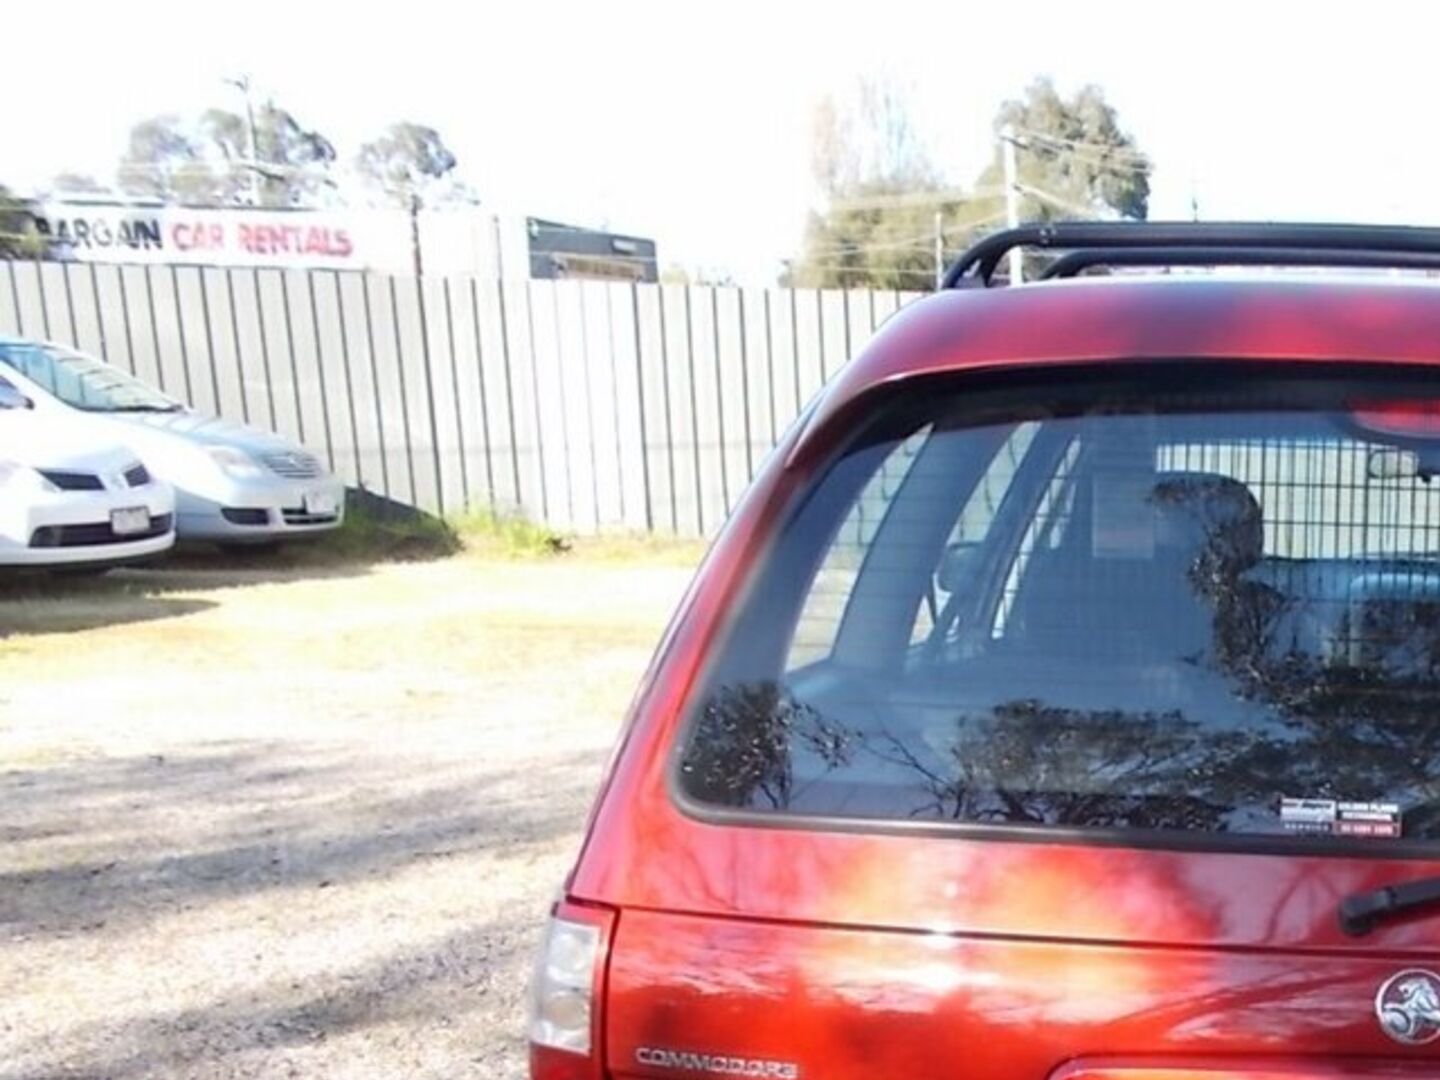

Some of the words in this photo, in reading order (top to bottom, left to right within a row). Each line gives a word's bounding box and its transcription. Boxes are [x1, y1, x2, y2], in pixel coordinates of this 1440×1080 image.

[172, 222, 224, 251] CAR
[238, 223, 353, 257] RENTALS
[636, 1047, 798, 1080] COMMODORE
